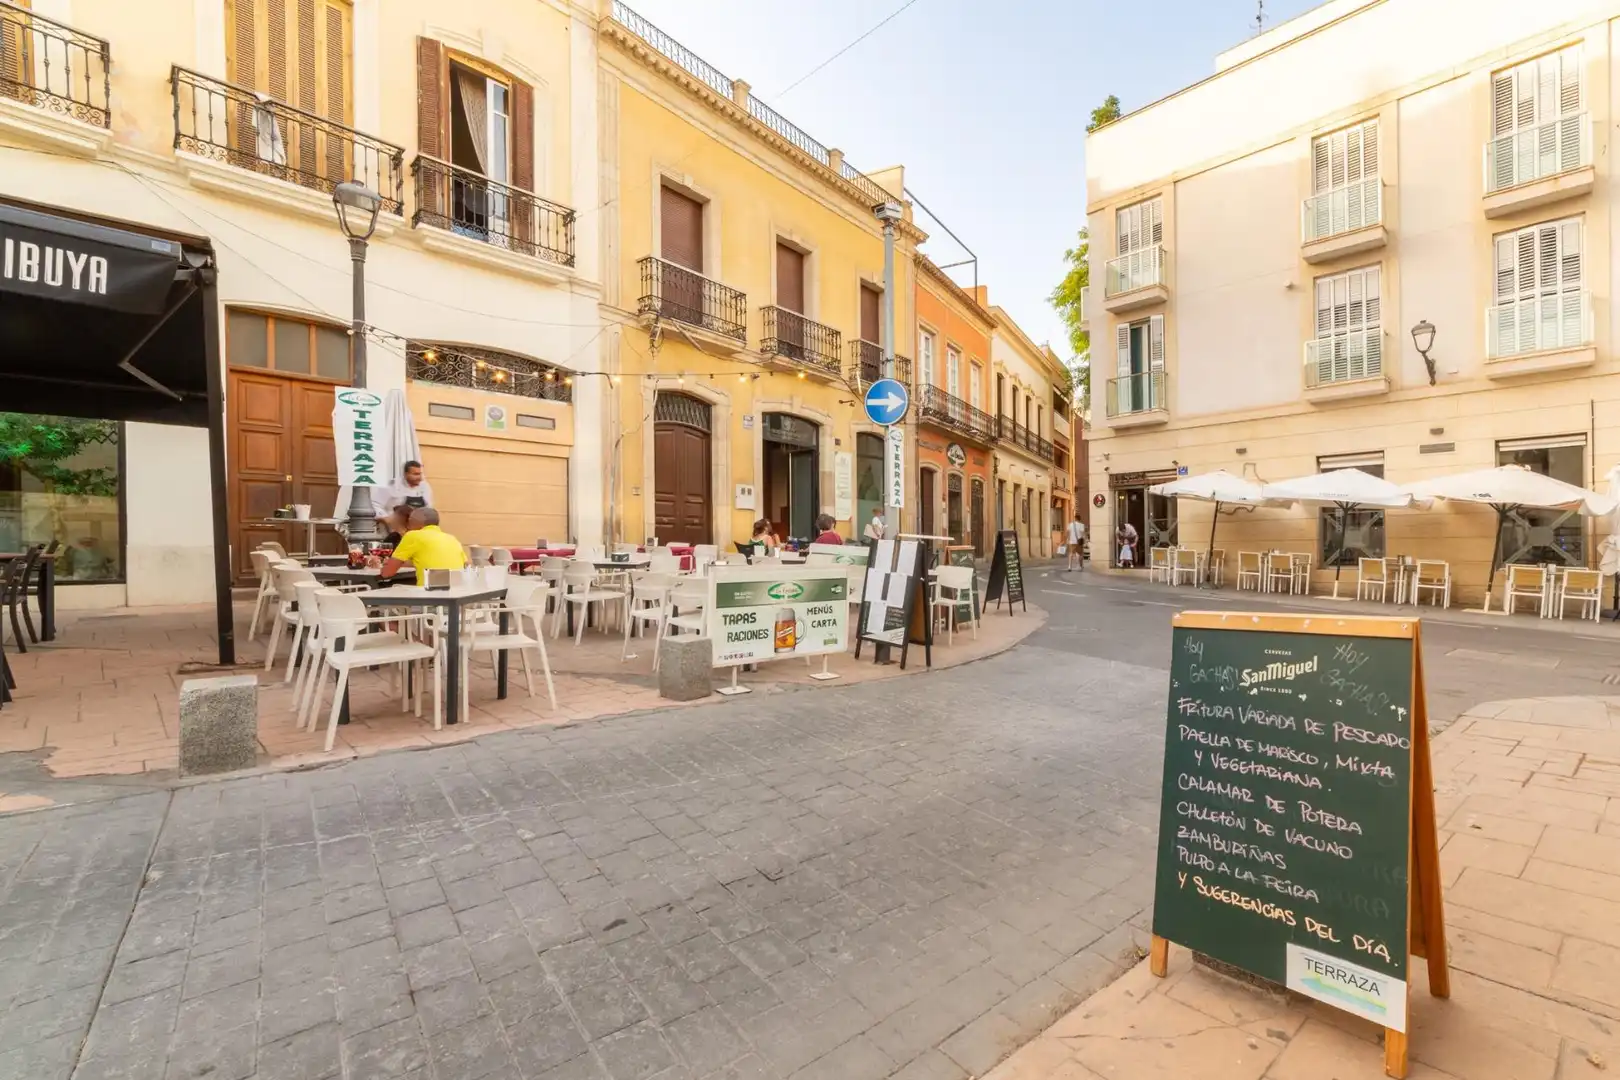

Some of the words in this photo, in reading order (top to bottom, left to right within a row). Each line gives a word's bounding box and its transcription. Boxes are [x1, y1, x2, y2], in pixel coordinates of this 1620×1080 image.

[4, 237, 107, 294] IBUYA
[352, 409, 376, 484] TERRAZA
[893, 444, 901, 506] TERRAZA
[722, 612, 757, 626] TAPAS
[806, 605, 833, 616] MENÚS
[811, 618, 837, 629] CARTA
[726, 628, 769, 643] RACIONES
[1178, 724, 1231, 748] PAELLA
[1235, 738, 1256, 752] DE
[1304, 718, 1326, 735] DE
[1333, 721, 1411, 749] PESCADO
[1178, 772, 1255, 802] CALAMAR
[1265, 795, 1286, 814] DE
[1297, 800, 1363, 836] POTERA
[1254, 818, 1275, 837] DE
[1285, 828, 1353, 859] VACUNO
[1176, 845, 1215, 872] PULPO
[1218, 862, 1231, 876] A
[1235, 868, 1261, 884] LA
[1178, 871, 1188, 889] Y
[1193, 876, 1297, 926] SUGERENCIAS
[1305, 917, 1342, 943] DEL
[1304, 957, 1380, 997] TERRAZA
